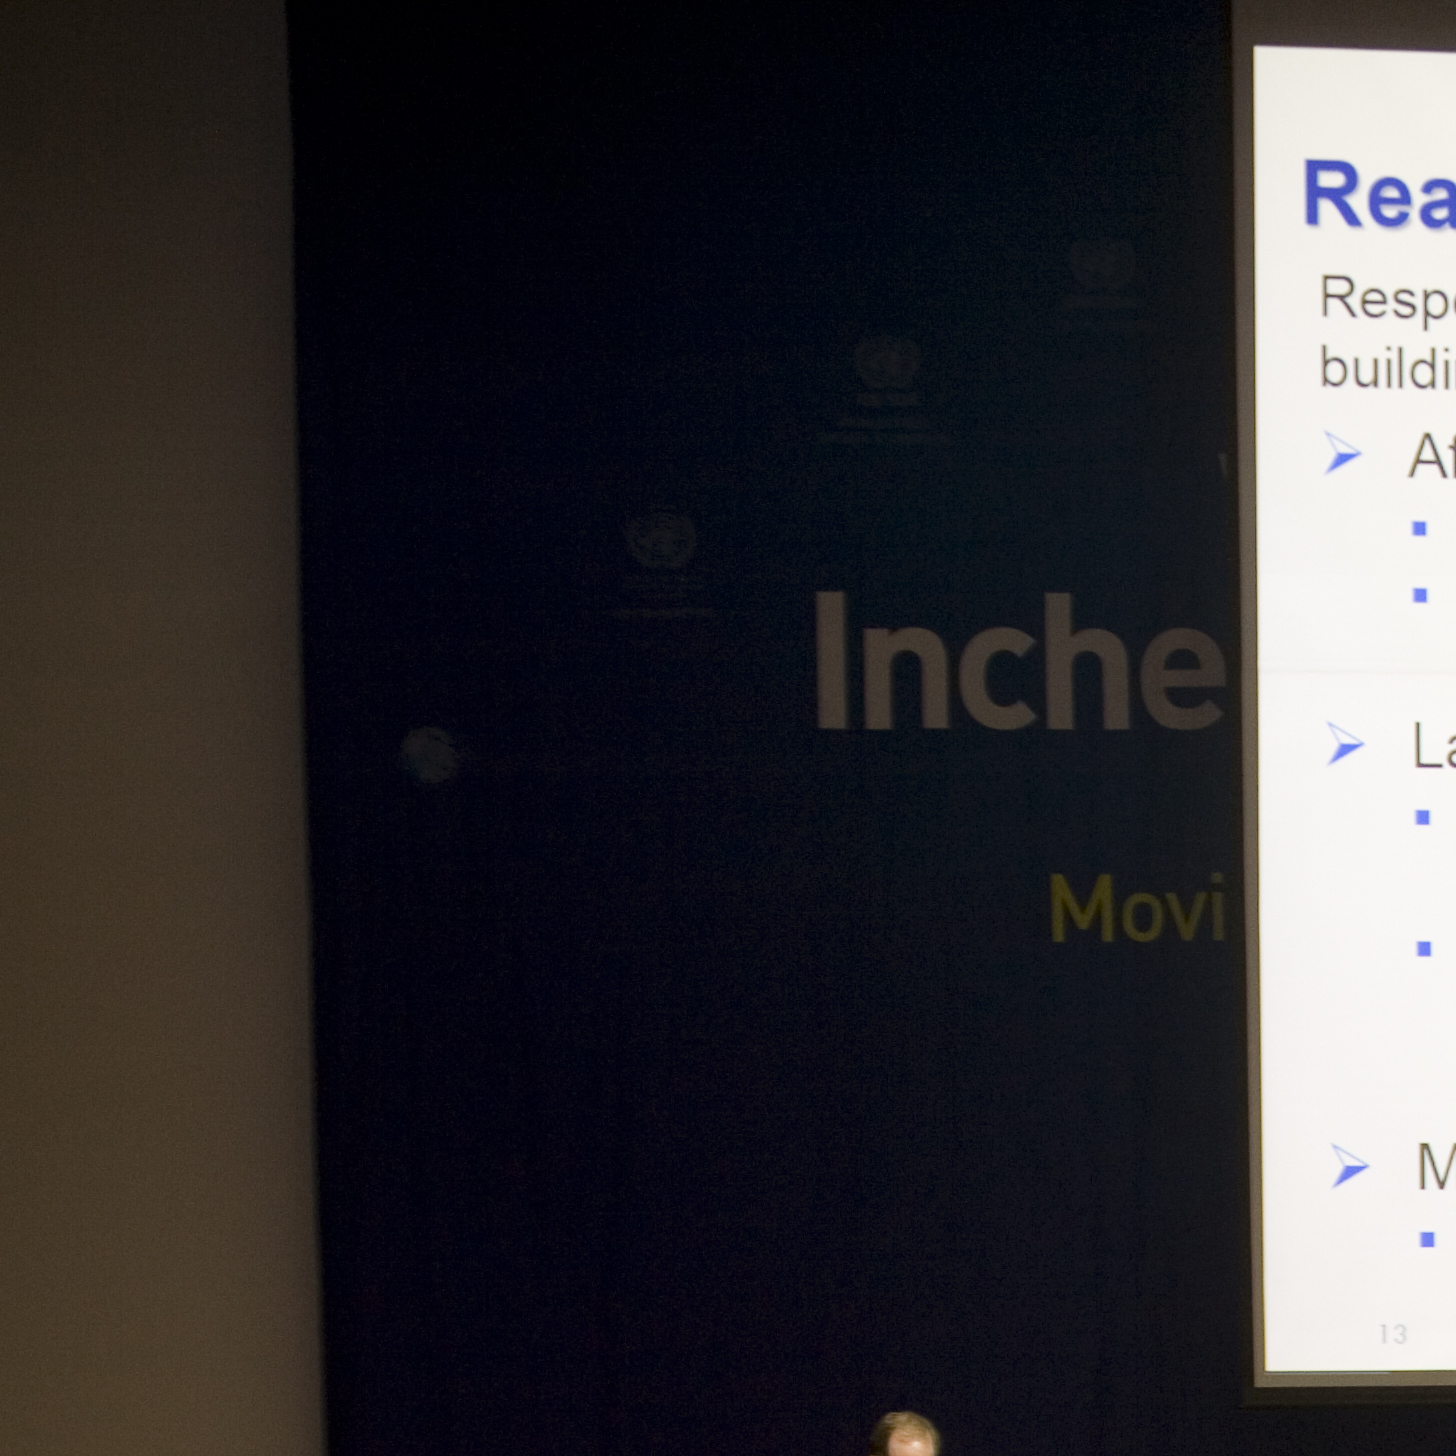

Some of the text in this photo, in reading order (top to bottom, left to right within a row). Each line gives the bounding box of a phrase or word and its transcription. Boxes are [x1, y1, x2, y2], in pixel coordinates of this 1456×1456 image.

[814, 590, 1227, 731] Inche
[1050, 872, 1225, 943] Movi
[1379, 1324, 1407, 1344] 13
